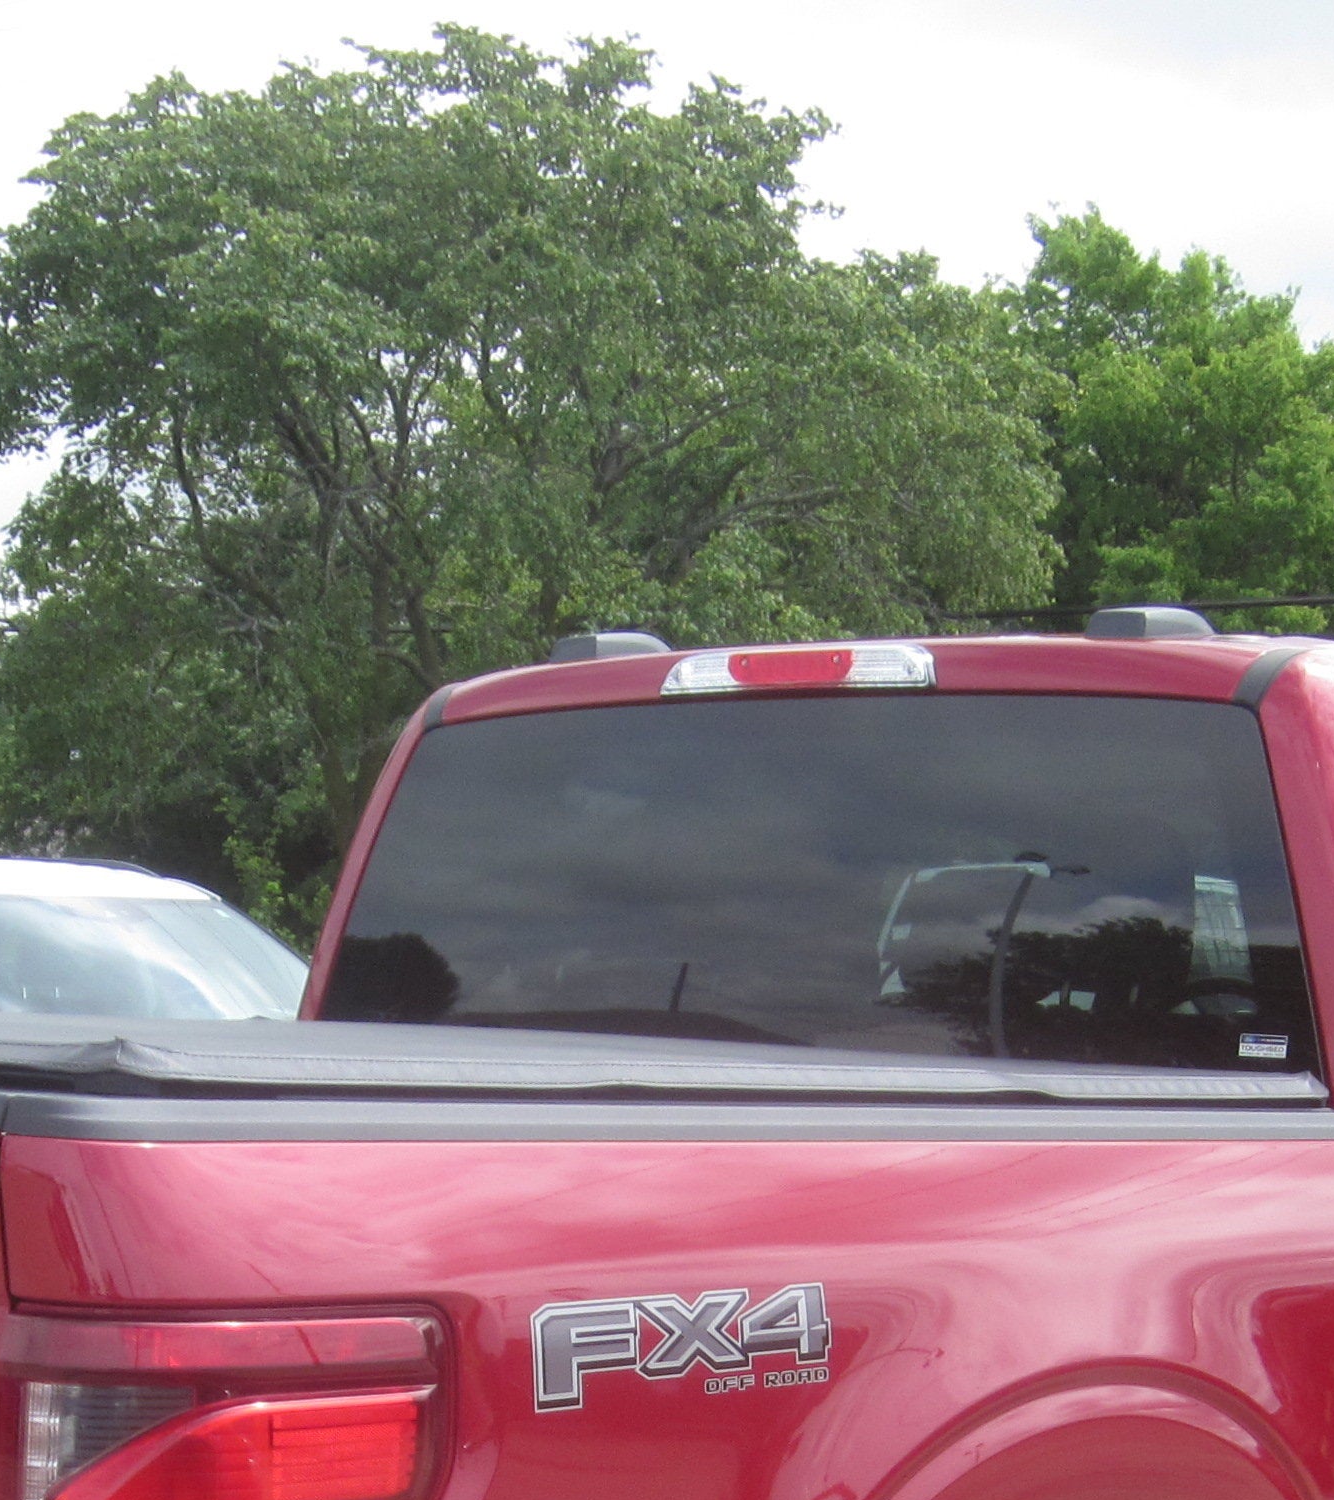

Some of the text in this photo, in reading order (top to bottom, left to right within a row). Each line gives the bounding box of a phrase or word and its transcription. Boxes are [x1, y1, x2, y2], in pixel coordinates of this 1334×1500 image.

[530, 1282, 831, 1413] FX4
[705, 1367, 829, 1394] OFF ROAD
